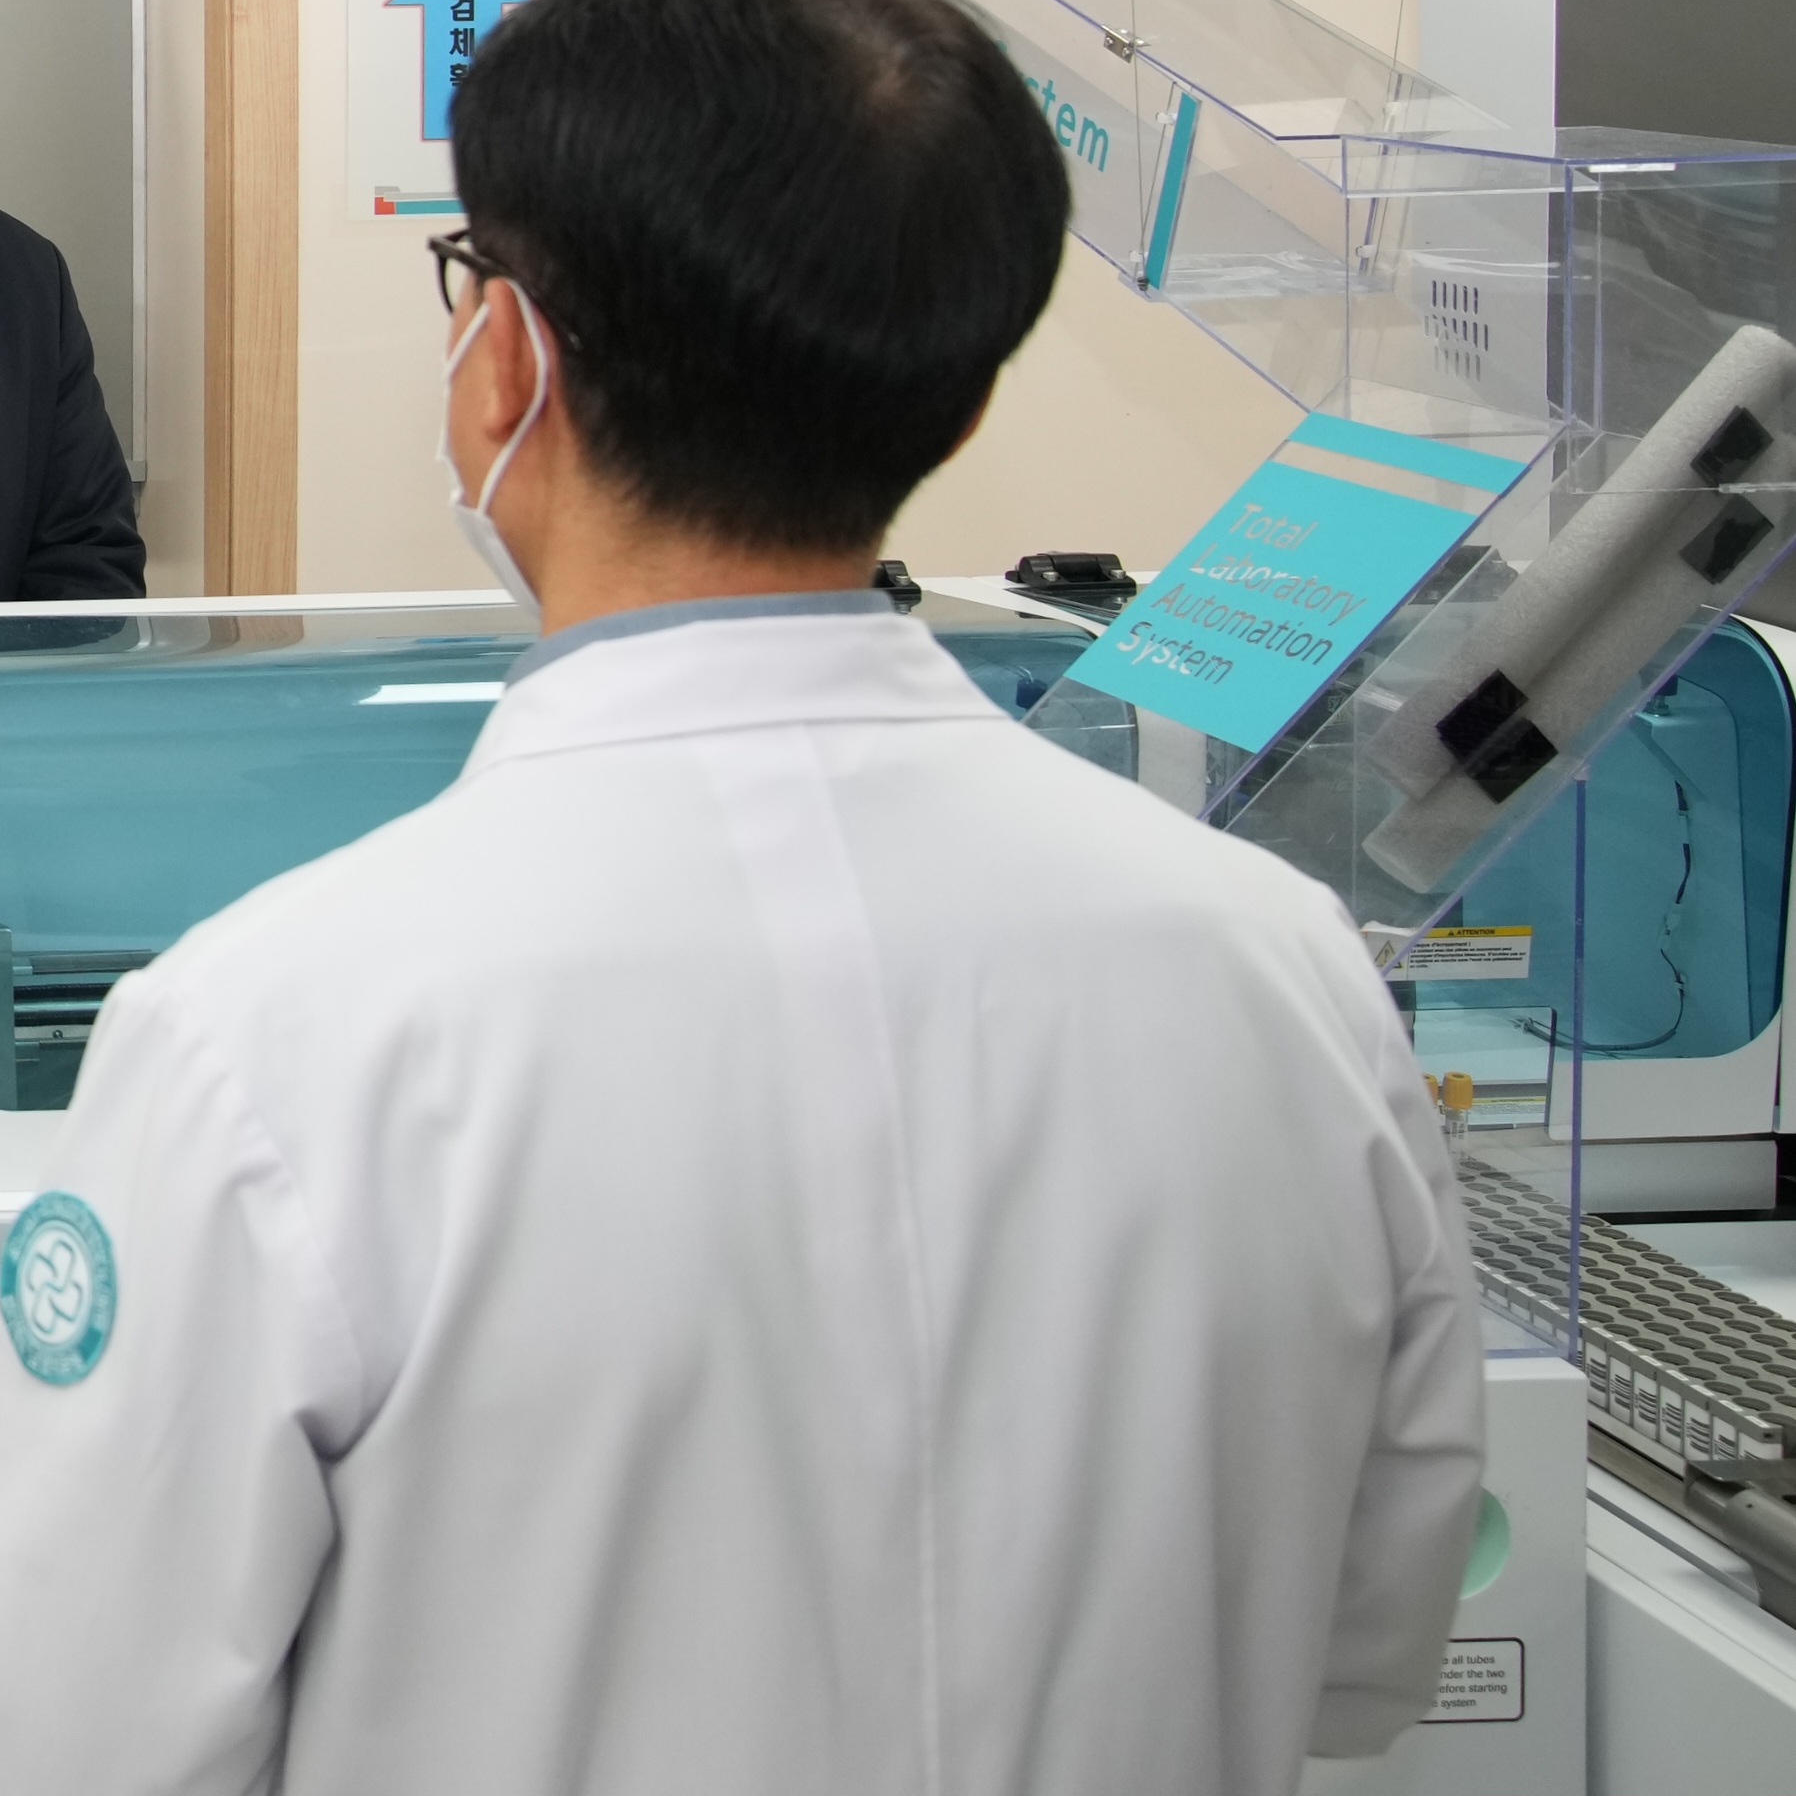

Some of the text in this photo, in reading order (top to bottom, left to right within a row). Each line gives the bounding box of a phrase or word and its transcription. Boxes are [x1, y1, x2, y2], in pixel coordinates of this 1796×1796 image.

[1228, 502, 1319, 550] Total
[1188, 542, 1367, 626] Laboratory
[1151, 583, 1333, 666] Automation
[1116, 620, 1234, 685] System
[1456, 928, 1495, 936] ATTENTION
[1452, 1655, 1464, 1665] all
[1466, 1655, 1496, 1665] tubes
[1440, 1669, 1505, 1680] nder the two
[1439, 1683, 1508, 1695] efore starting
[1441, 1698, 1477, 1710] system
